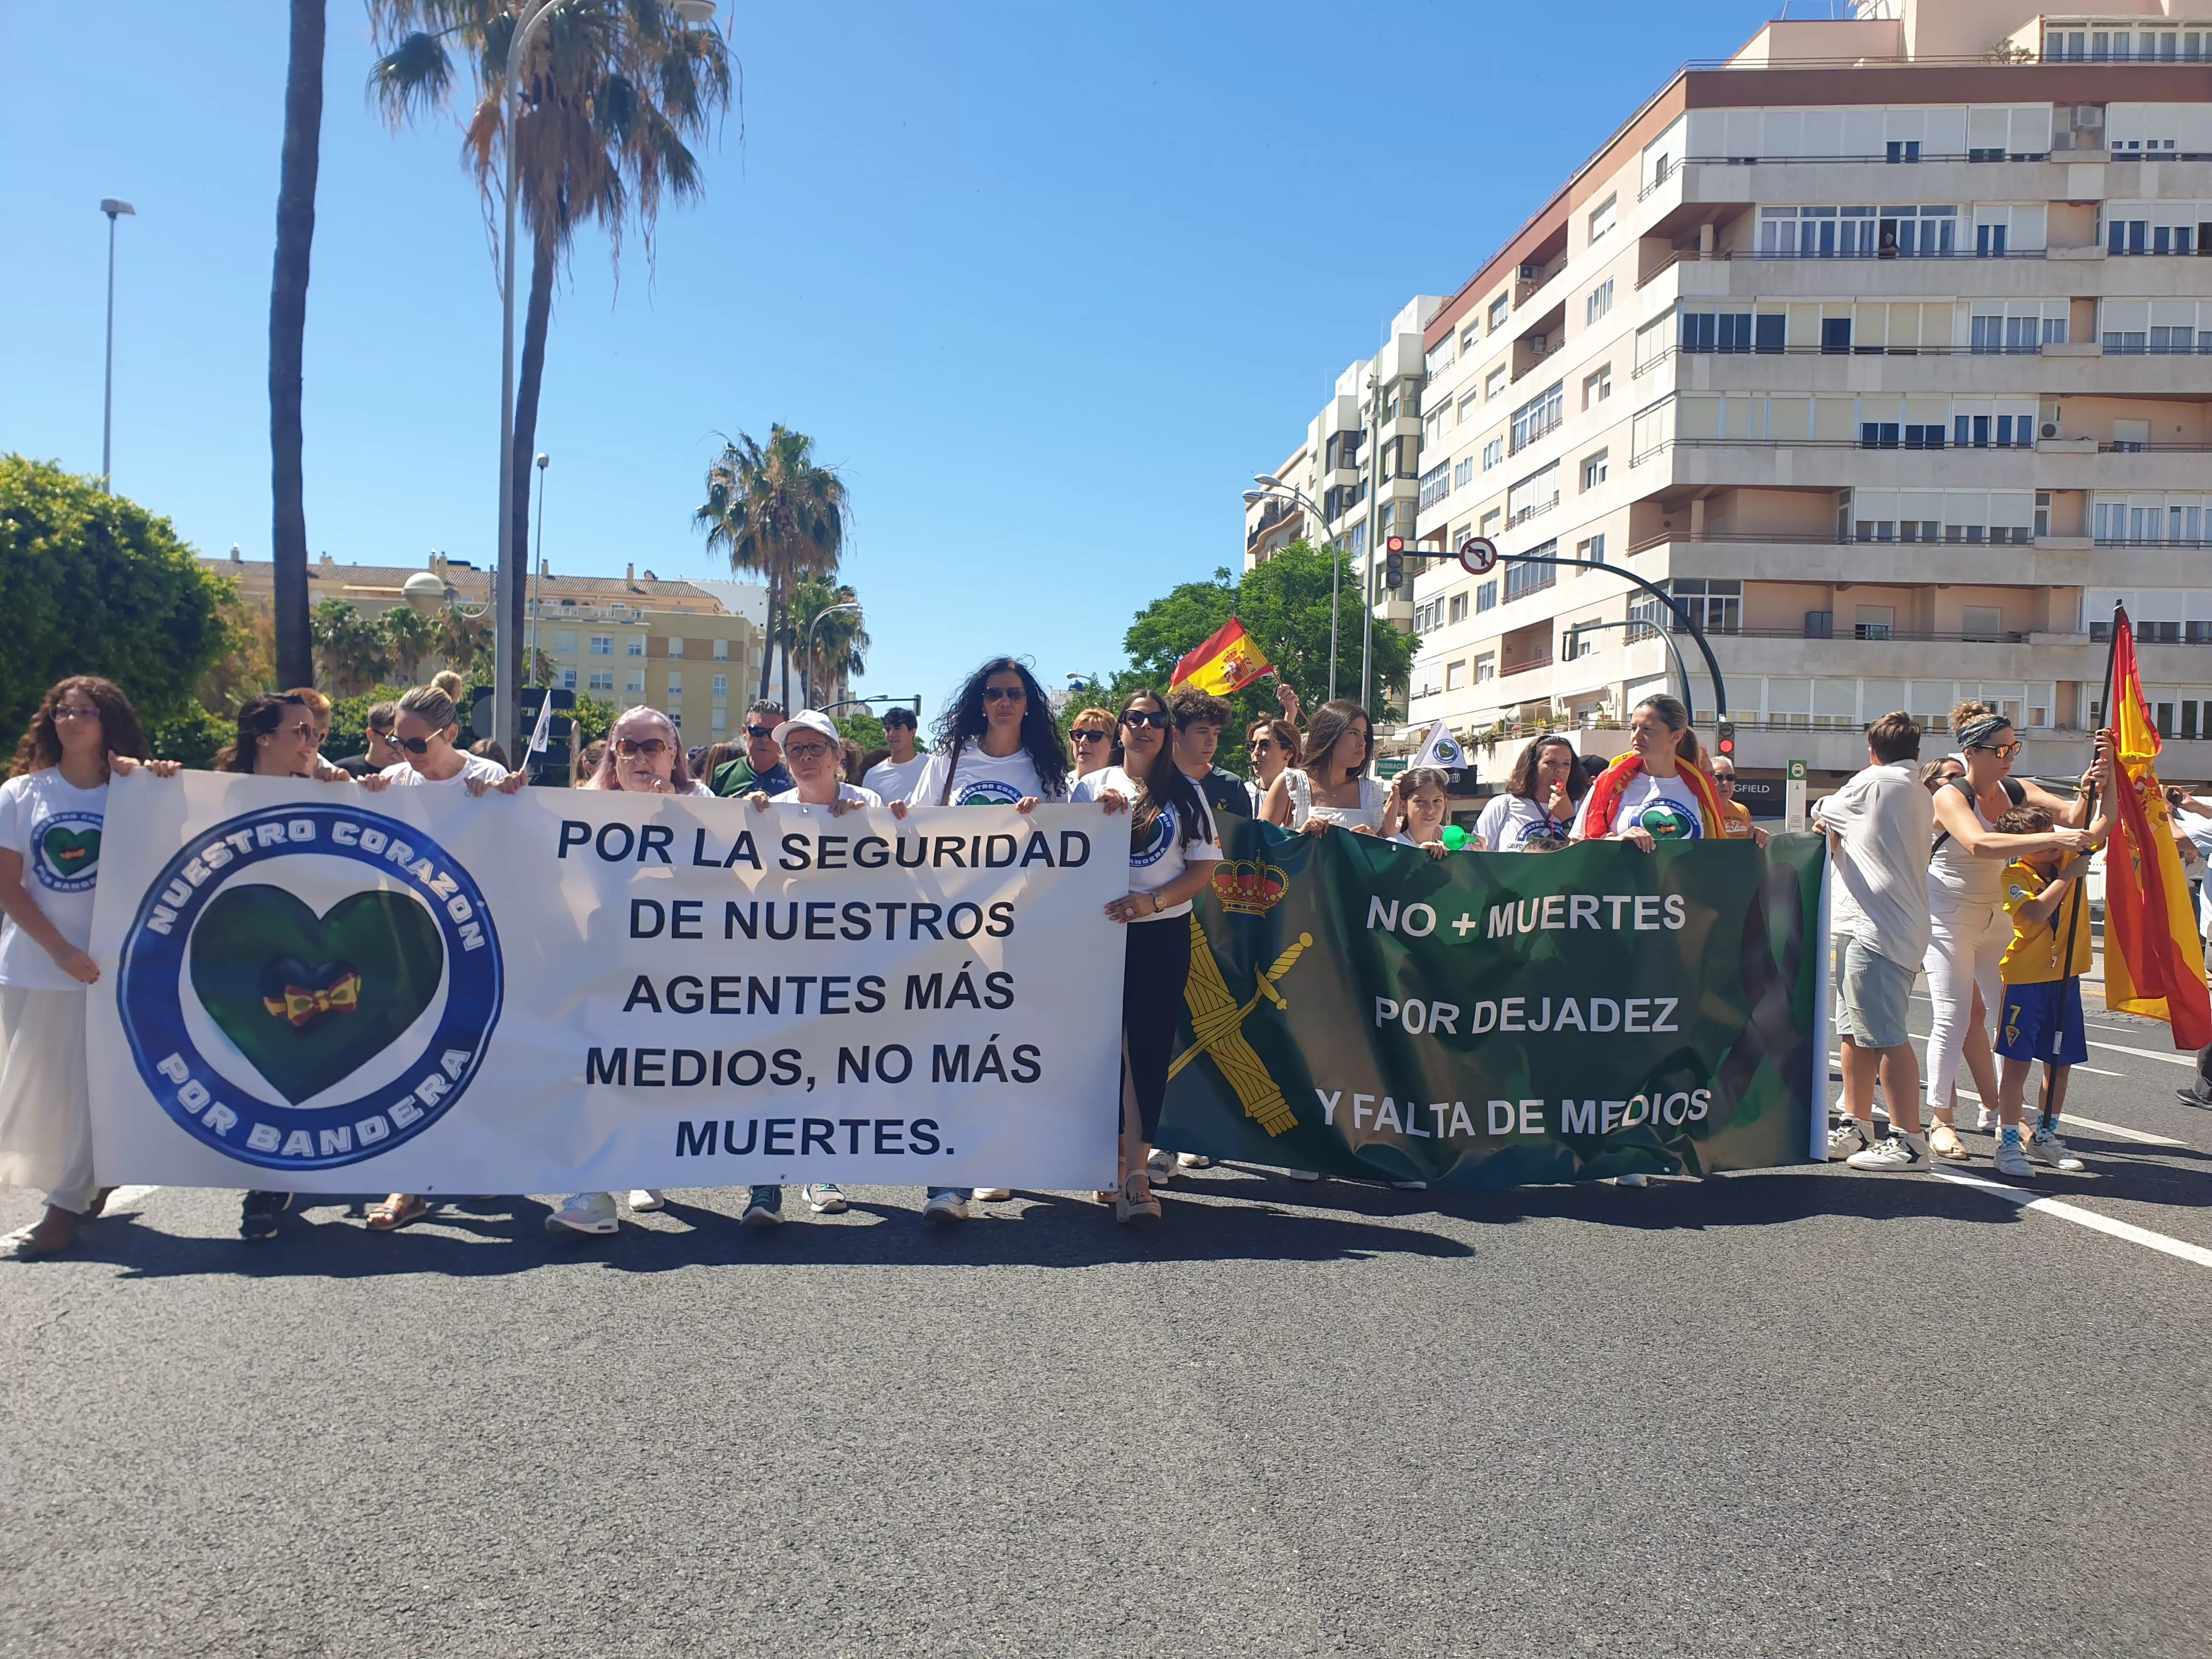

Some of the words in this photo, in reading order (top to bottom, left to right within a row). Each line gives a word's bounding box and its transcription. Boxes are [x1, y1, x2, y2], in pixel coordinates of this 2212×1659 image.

[557, 820, 674, 864] POR
[692, 828, 763, 870] LA
[778, 831, 1091, 871] SEGURIDAD
[146, 819, 316, 935] NUESTRO
[630, 899, 703, 939] DE
[725, 901, 1015, 941] NUESTROS
[1367, 895, 1437, 937] NO
[1452, 912, 1476, 936] +
[1487, 894, 1686, 939] MUERTES
[623, 975, 886, 1014] AGENTES
[905, 961, 1015, 1011] MÁS
[1375, 995, 1460, 1035] POR
[1471, 997, 1679, 1034] DEJADEZ
[2010, 1005, 2021, 1025] 7
[585, 1047, 816, 1093] MEDIOS,
[838, 1044, 912, 1084] NO
[932, 1034, 1042, 1084] MÁS
[157, 1052, 238, 1137] POR
[246, 1049, 472, 1157] BANDERA
[1316, 1088, 1342, 1125] Y
[1353, 1093, 1476, 1139] FALTA
[1487, 1099, 1545, 1135] DE
[1562, 1088, 1712, 1135] MEDIOS
[676, 1118, 955, 1157] MUERTES.
